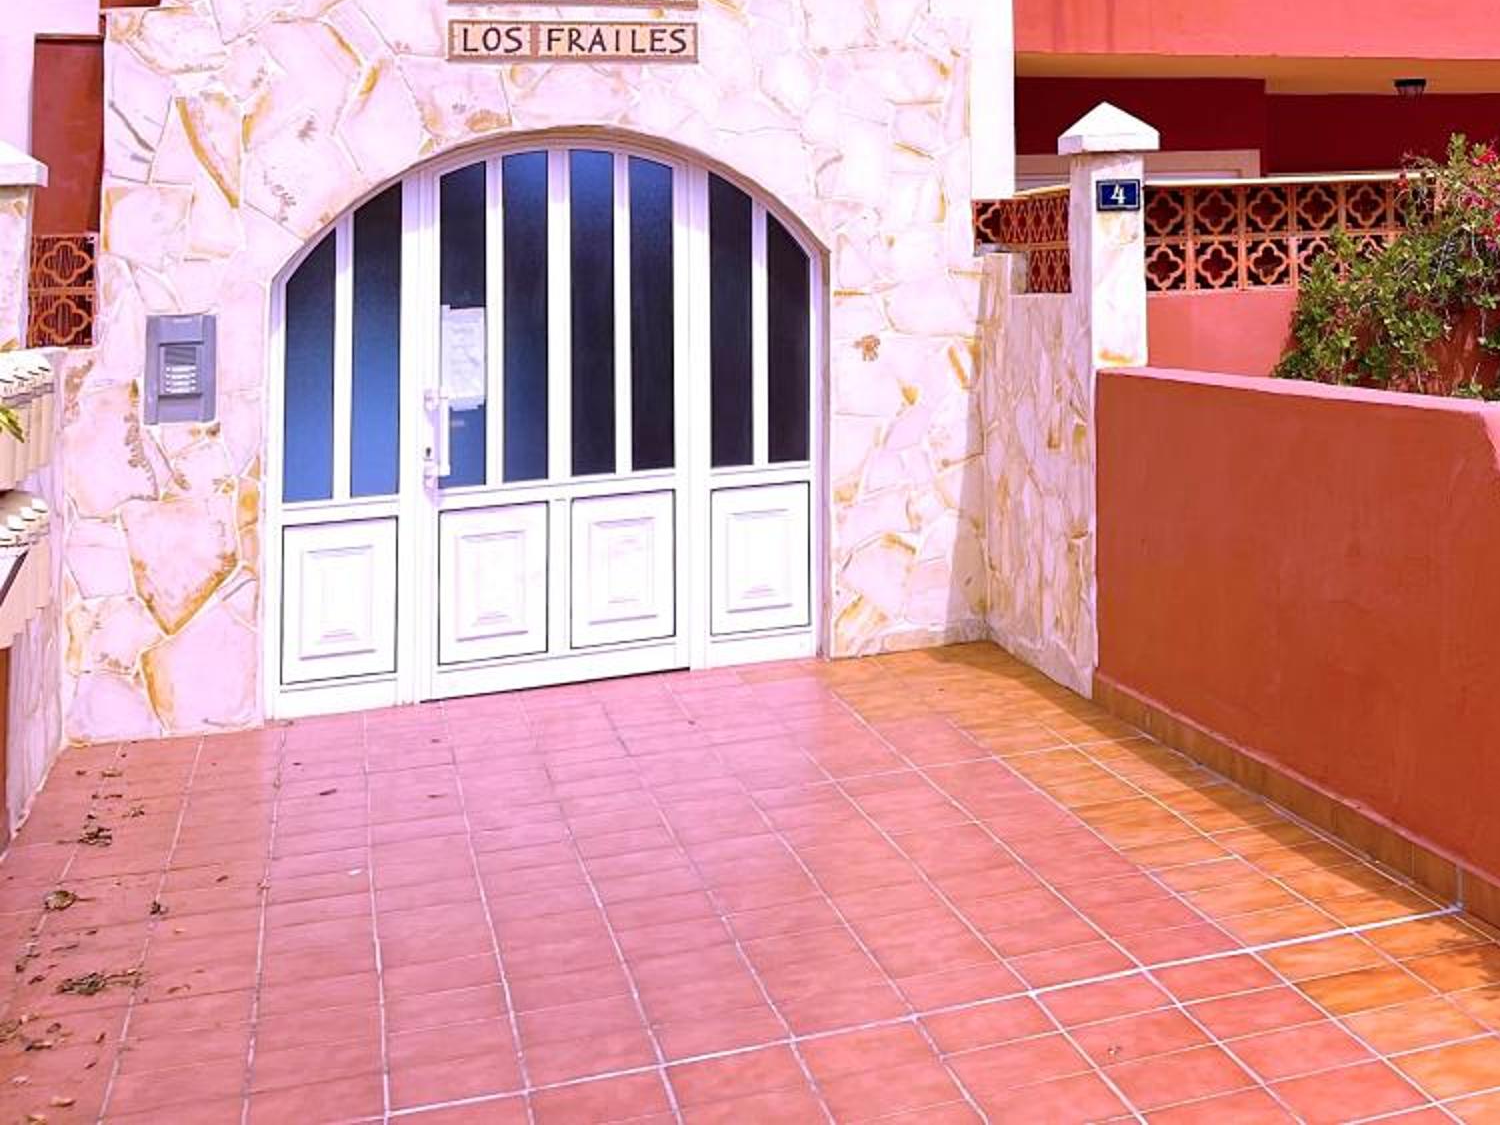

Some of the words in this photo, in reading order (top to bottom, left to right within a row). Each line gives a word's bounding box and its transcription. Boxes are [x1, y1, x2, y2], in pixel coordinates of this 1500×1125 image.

[462, 26, 523, 53] LOS
[547, 27, 687, 54] FRAILES
[1110, 183, 1127, 204] 4
